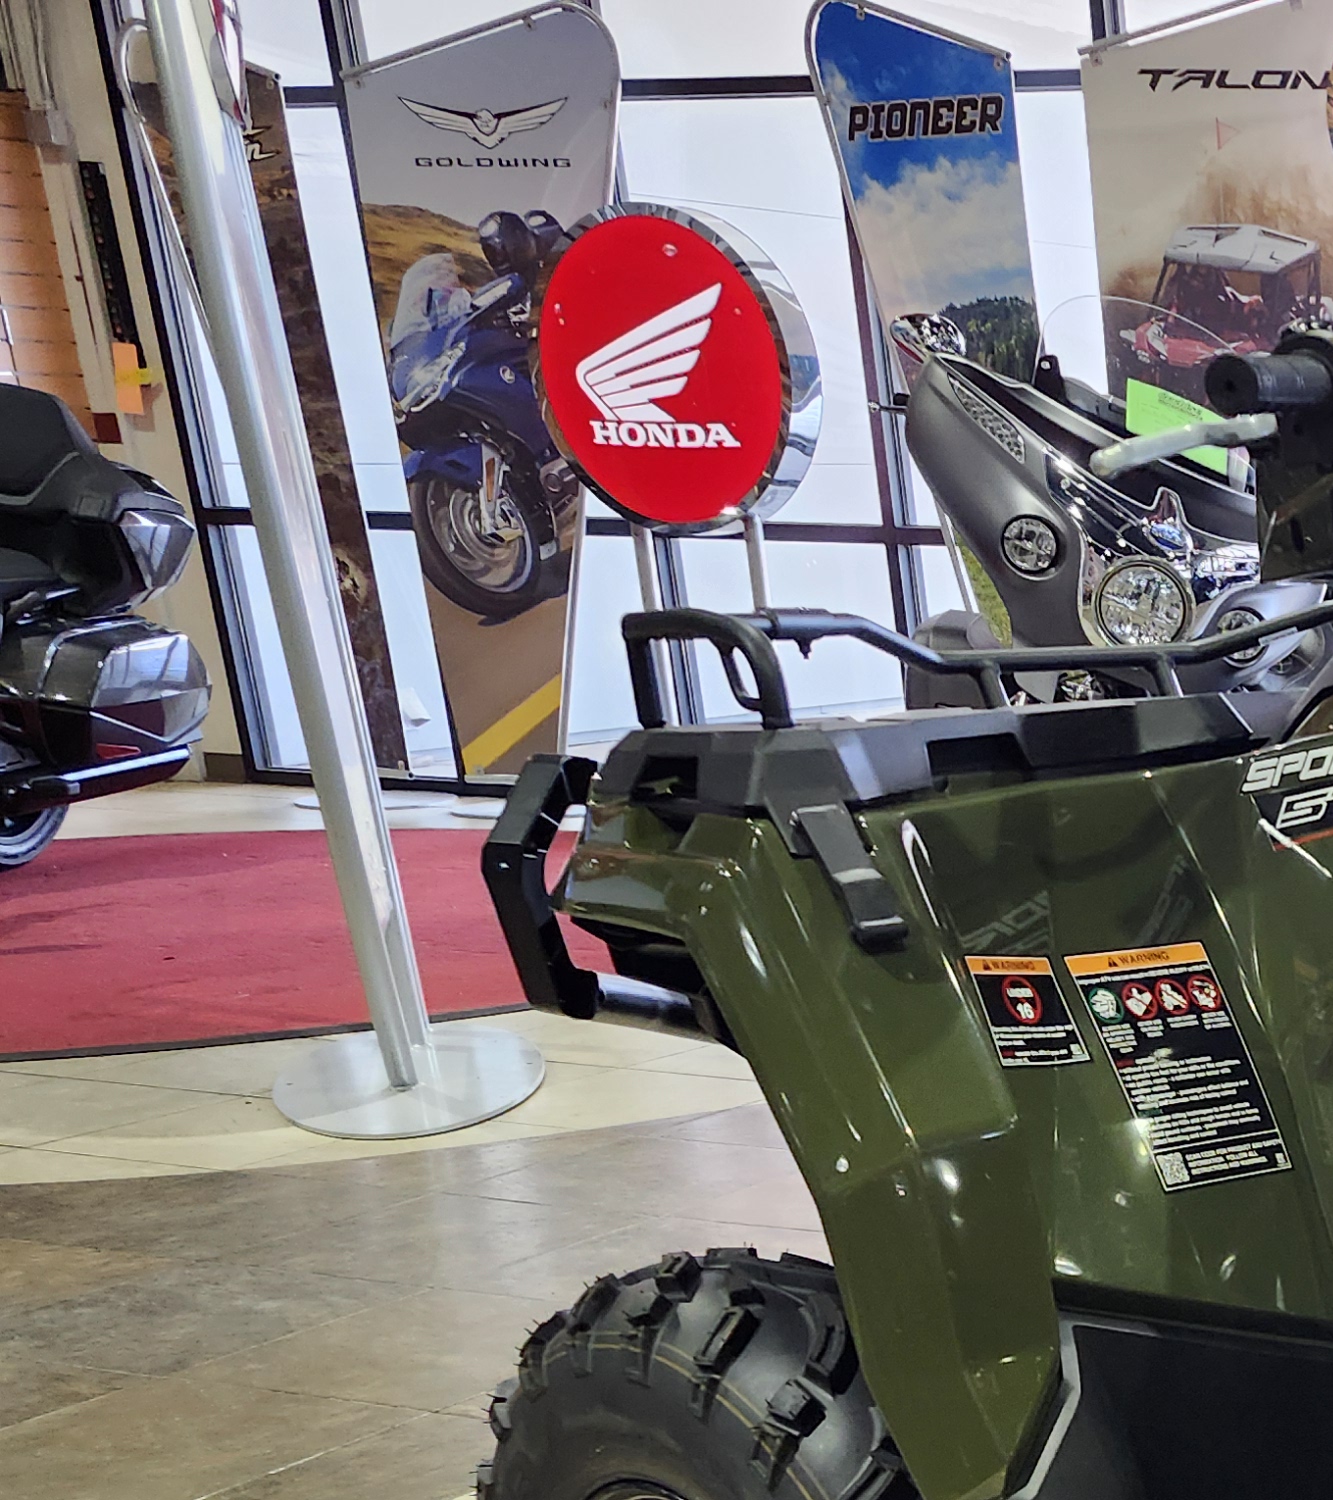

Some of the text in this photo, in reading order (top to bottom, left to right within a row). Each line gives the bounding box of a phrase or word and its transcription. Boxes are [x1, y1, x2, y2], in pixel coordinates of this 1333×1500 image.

[1137, 68, 1333, 92] TALON
[847, 94, 1004, 143] PIONEER
[414, 157, 571, 168] GOLDWING
[589, 420, 741, 448] HONDA
[1117, 950, 1170, 966] WARNING
[1016, 1001, 1035, 1020] 16
